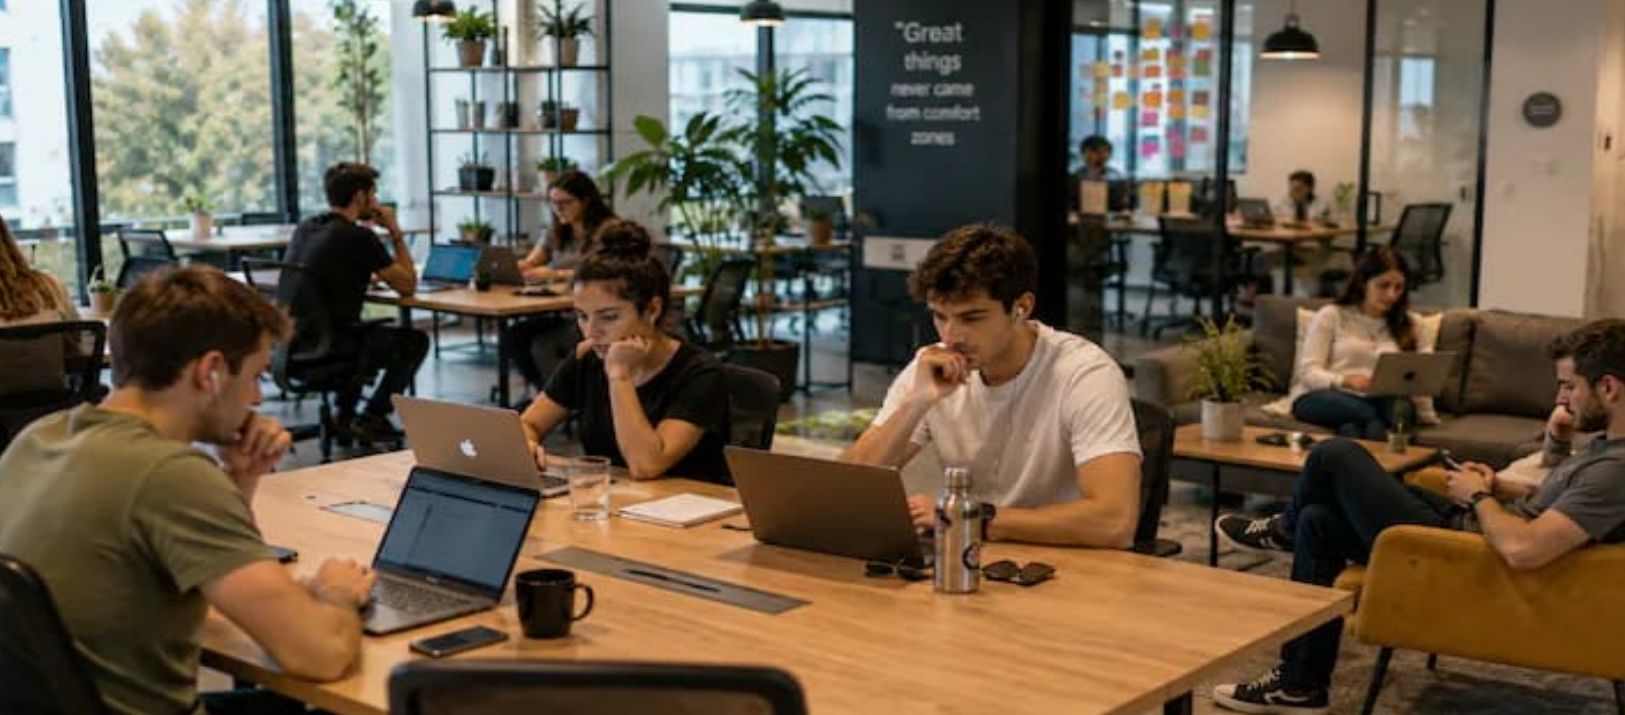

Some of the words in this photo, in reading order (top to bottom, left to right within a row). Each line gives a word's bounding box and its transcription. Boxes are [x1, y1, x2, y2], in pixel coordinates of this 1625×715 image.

[904, 51, 961, 75] things
[890, 83, 930, 96] never
[933, 83, 974, 96] came
[886, 104, 921, 120] from
[924, 104, 980, 120] comfort
[911, 131, 954, 145] zones
